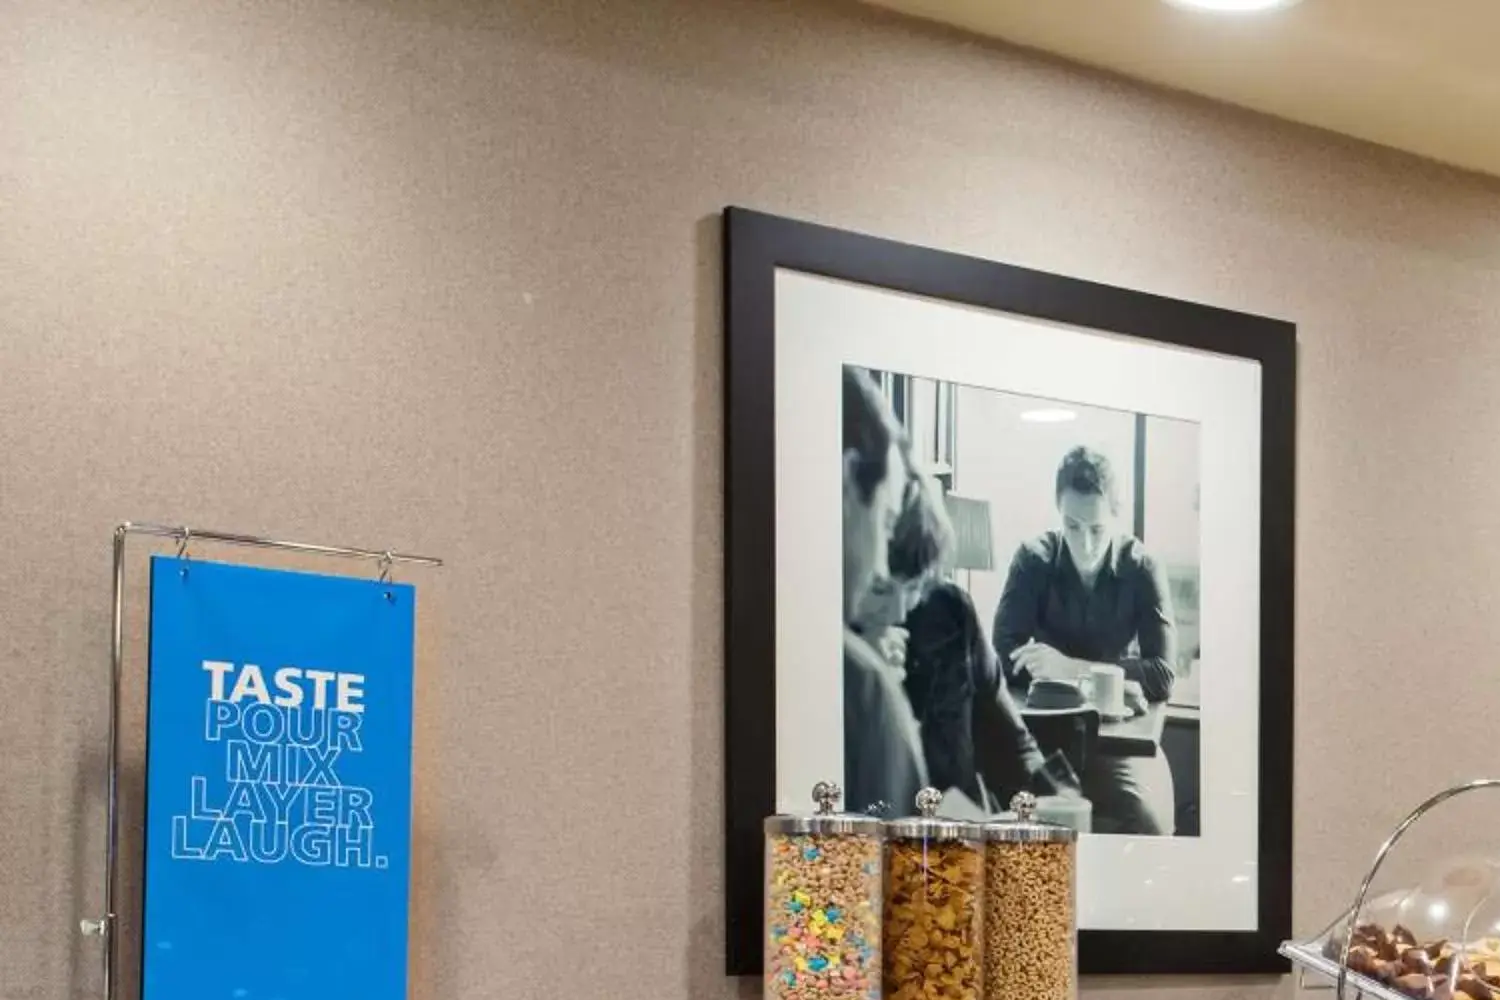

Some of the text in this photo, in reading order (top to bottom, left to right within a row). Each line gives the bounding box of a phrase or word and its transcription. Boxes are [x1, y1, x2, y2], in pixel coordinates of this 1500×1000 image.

[202, 660, 365, 713] TASTE
[205, 698, 363, 752] POUR
[227, 739, 341, 787] MIX
[191, 776, 374, 829] LAYER
[171, 815, 389, 869] LAUGH.
